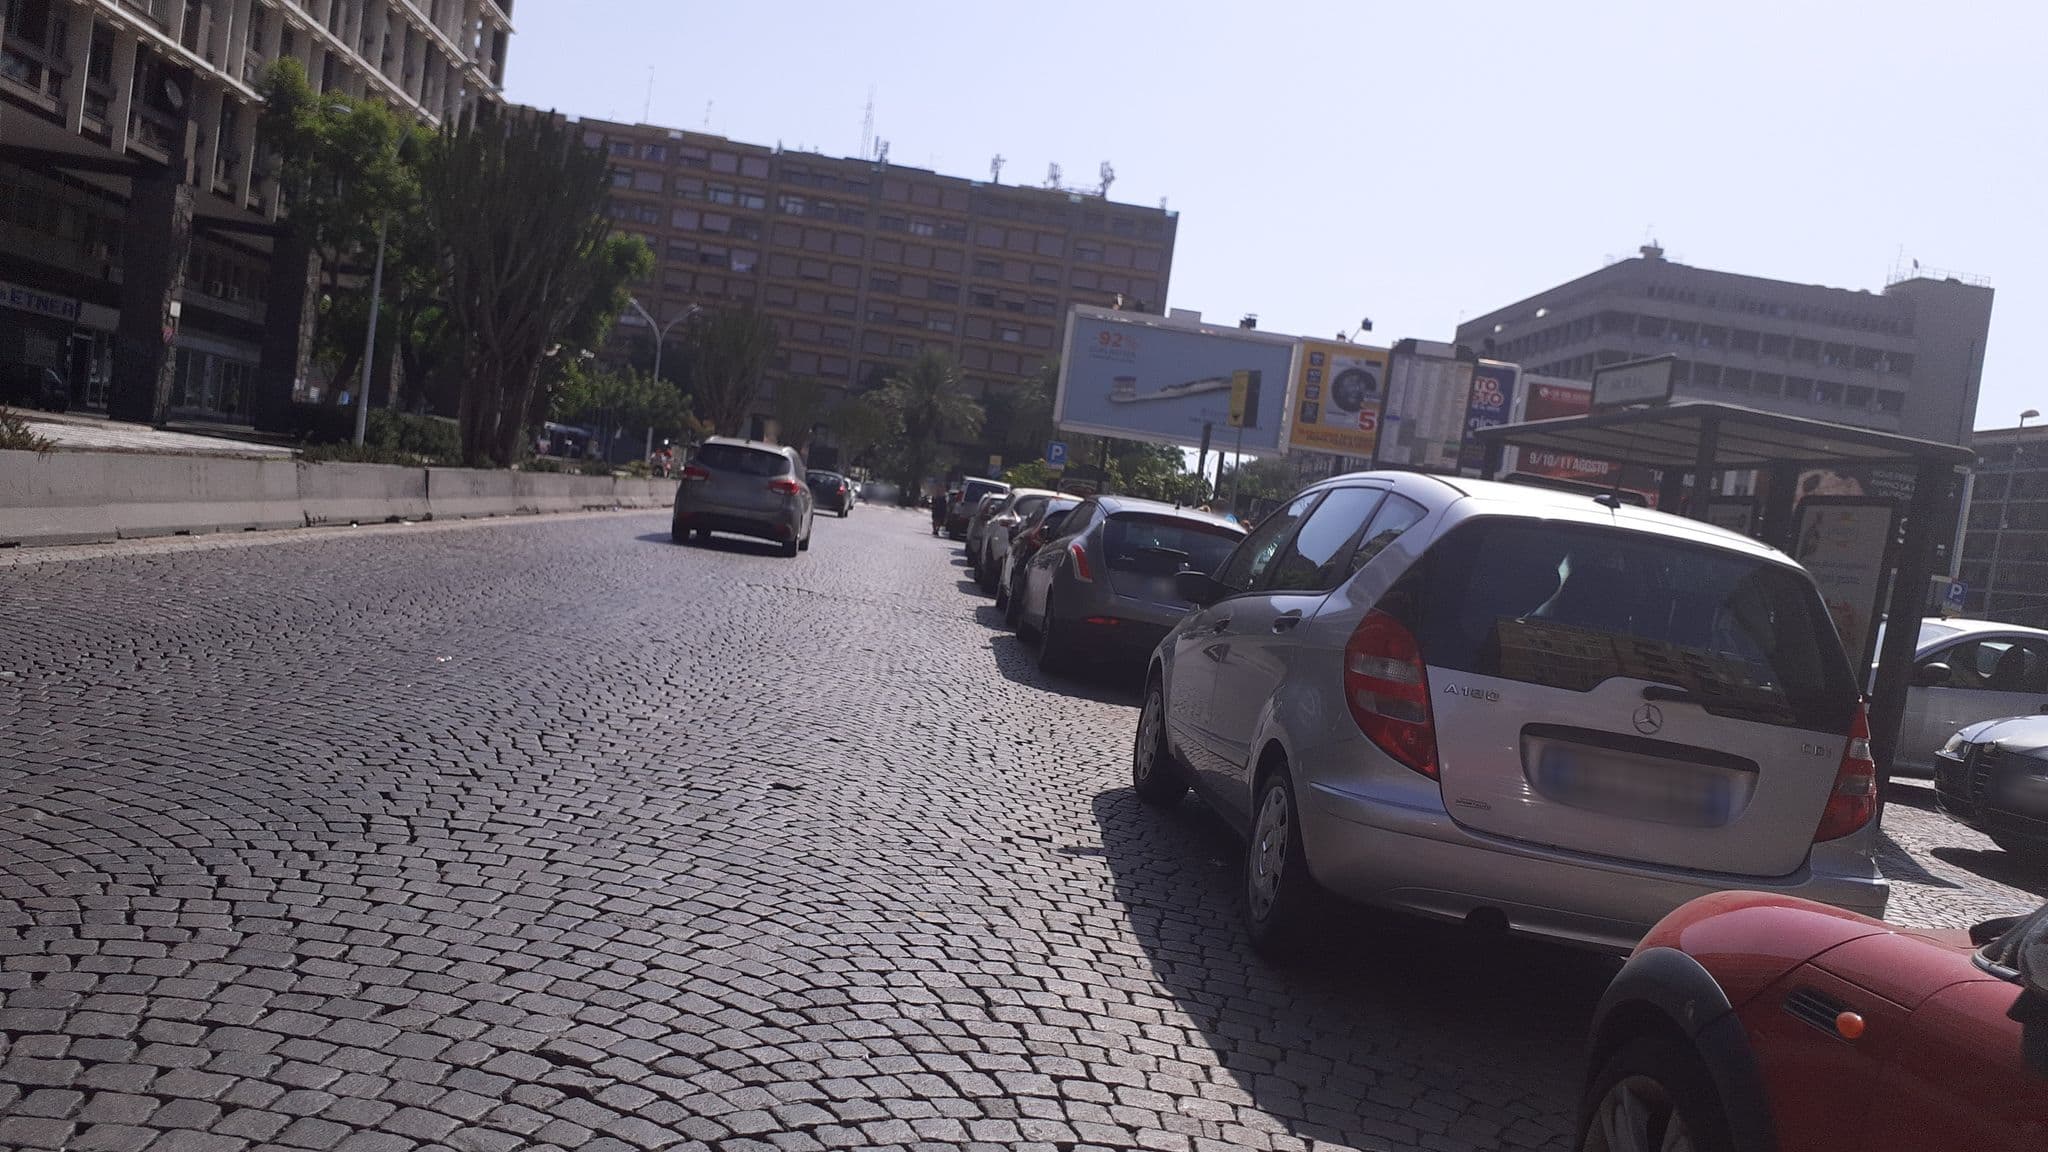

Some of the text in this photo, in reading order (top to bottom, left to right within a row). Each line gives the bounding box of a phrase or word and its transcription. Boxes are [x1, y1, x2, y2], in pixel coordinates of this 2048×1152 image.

[1359, 410, 1376, 431] 5
[1051, 445, 1063, 460] P
[1950, 584, 1963, 599] P
